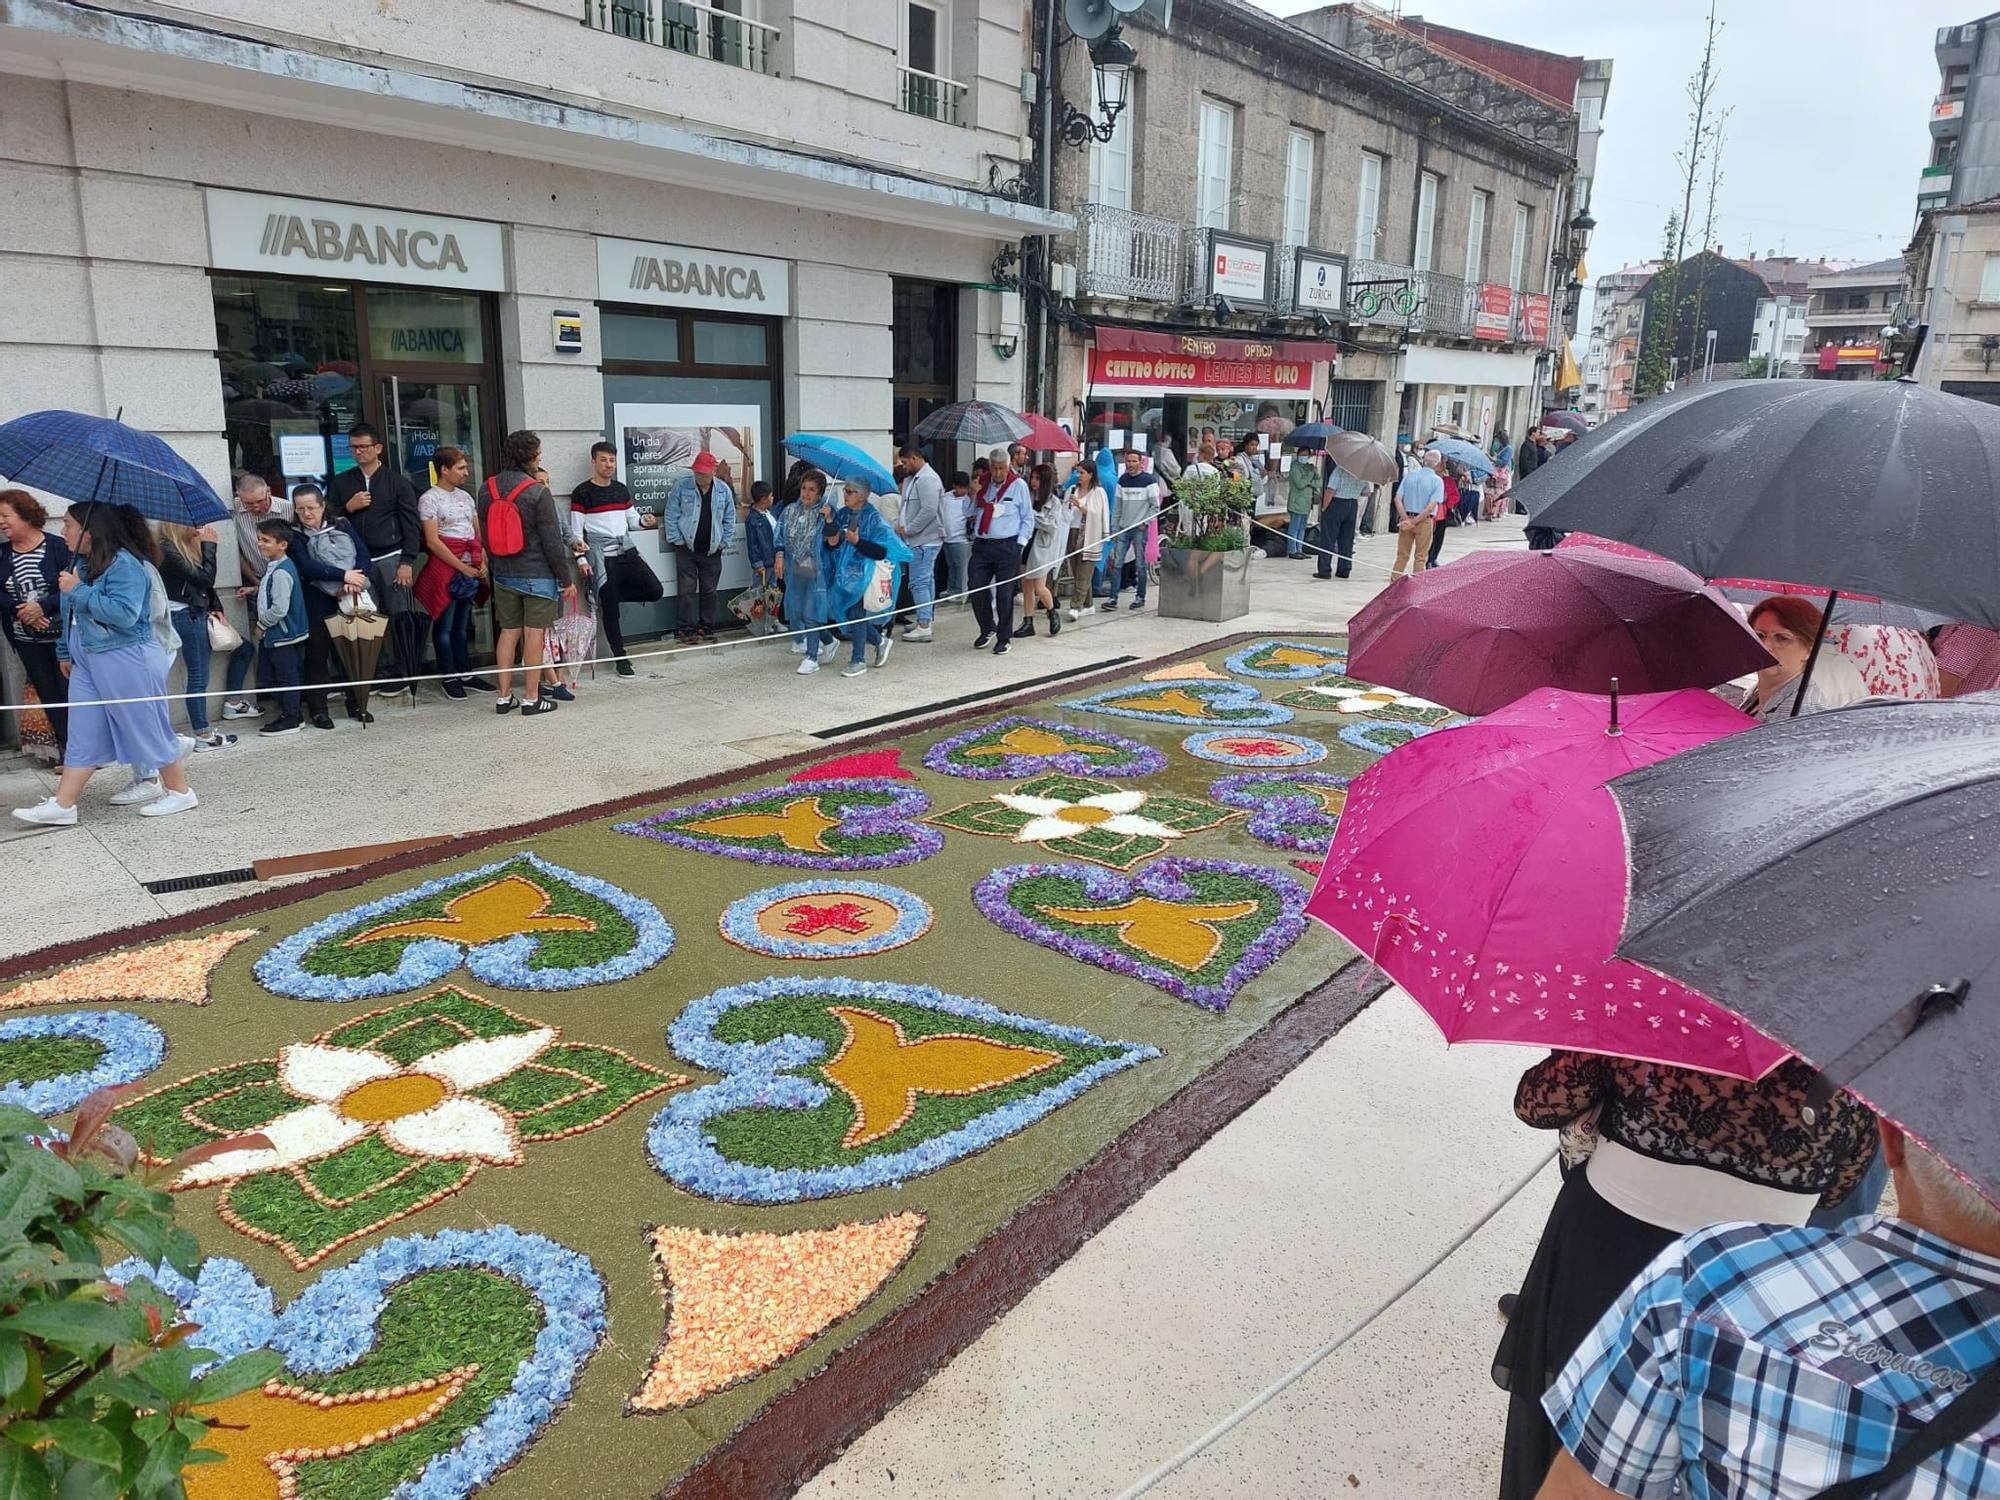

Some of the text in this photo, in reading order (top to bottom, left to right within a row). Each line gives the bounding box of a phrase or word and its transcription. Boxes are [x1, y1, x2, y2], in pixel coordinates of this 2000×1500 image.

[1308, 287, 1332, 301] ZURICH
[1181, 336, 1273, 357] CENTRO OPTICO
[1105, 358, 1299, 385] CENTRO ÓPTICO LENTES DE ORO
[632, 435, 646, 447] Un
[632, 451, 662, 463] queres
[633, 465, 666, 475] aprazar
[634, 493, 641, 501] e
[642, 491, 666, 500] outro
[1807, 1320, 1977, 1394] Starwear
